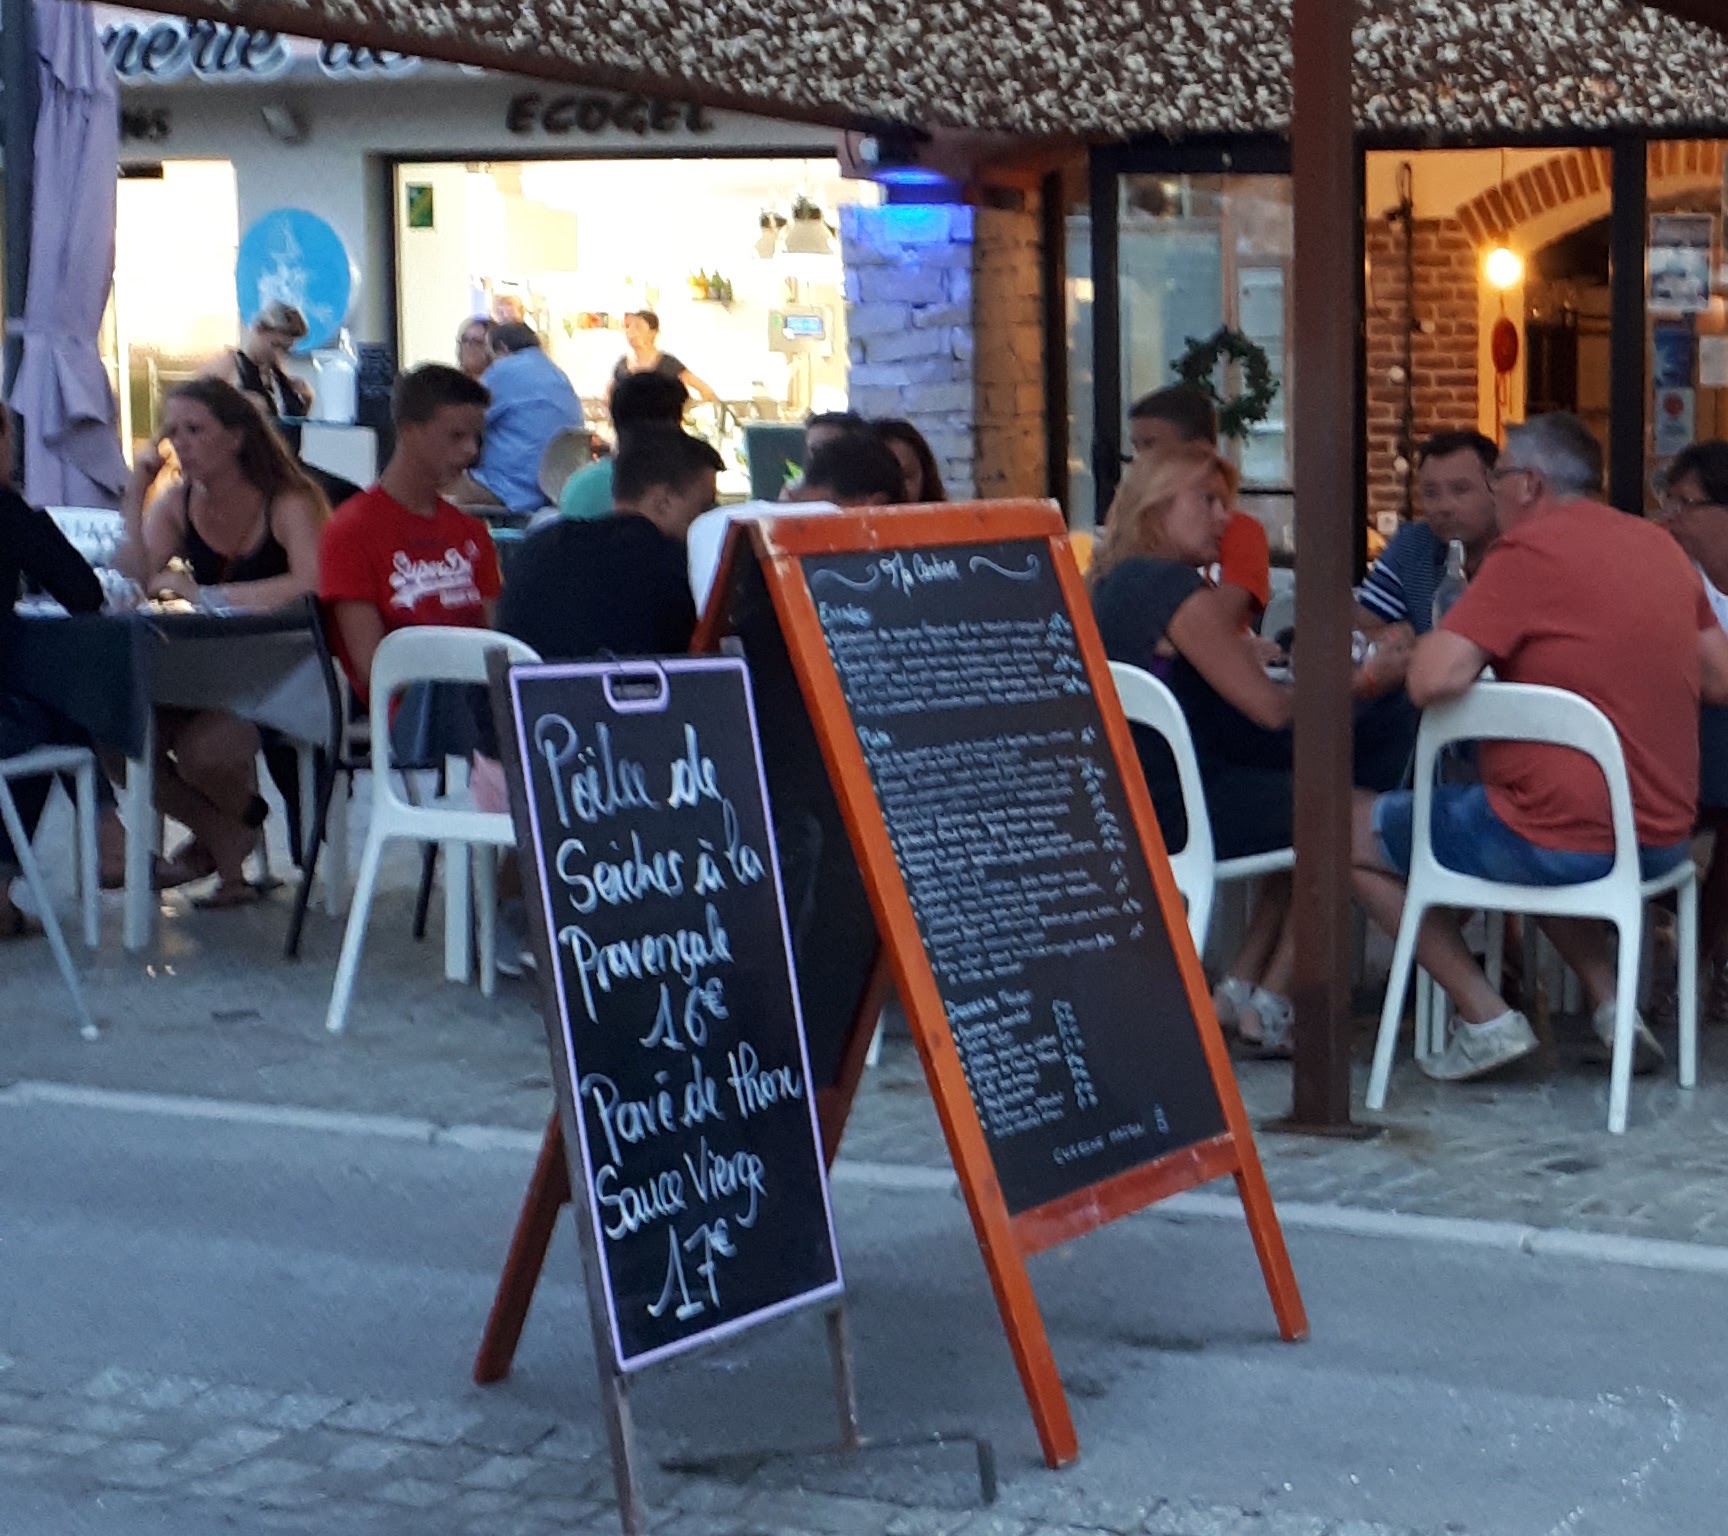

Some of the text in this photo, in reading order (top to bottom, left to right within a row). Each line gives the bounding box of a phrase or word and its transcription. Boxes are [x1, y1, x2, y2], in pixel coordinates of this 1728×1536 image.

[666, 722, 723, 809] de
[679, 1053, 726, 1128] de
[595, 1134, 769, 1240] Sauce Vierge
